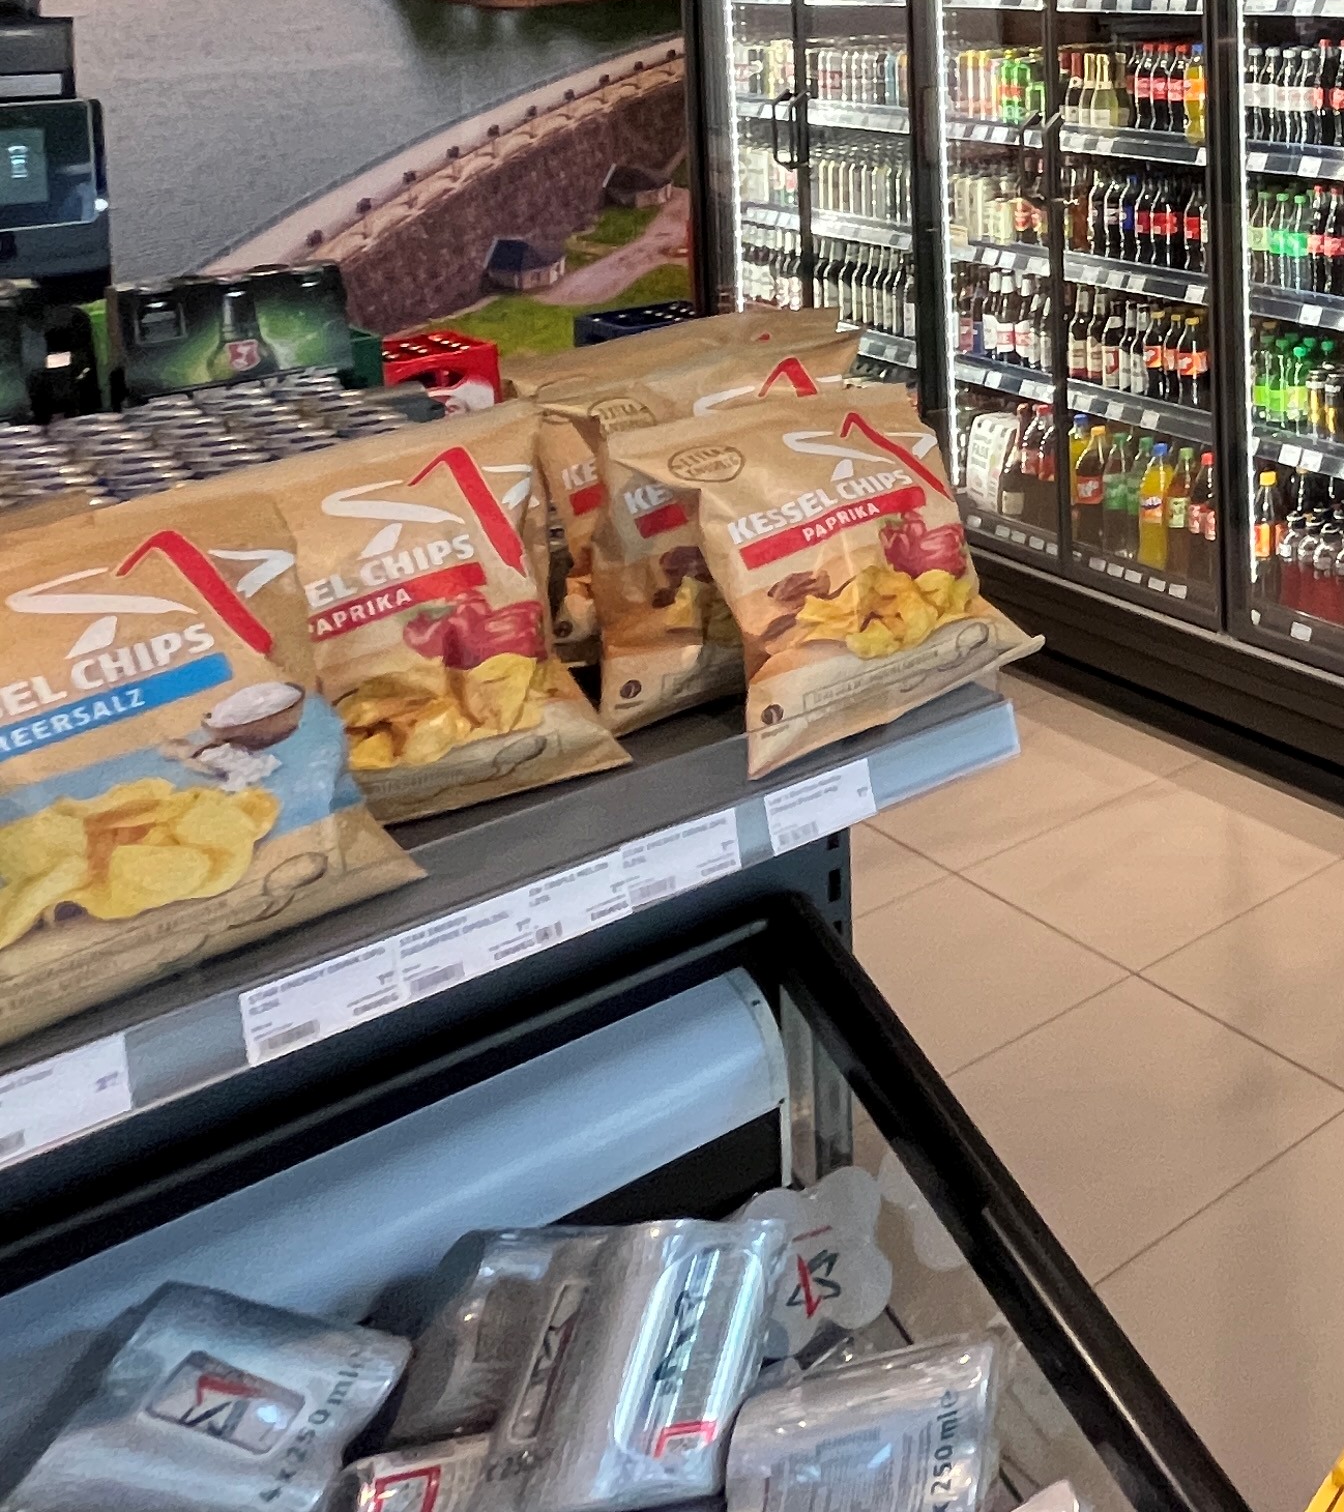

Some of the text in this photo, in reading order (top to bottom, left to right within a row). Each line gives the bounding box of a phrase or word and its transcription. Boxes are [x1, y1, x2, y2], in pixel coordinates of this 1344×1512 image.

[836, 468, 914, 501] CHIPS
[727, 488, 839, 545] KESSEL
[801, 502, 881, 543] PAPRIKA
[359, 534, 475, 587] CHIPS
[70, 623, 215, 690] CHIPS
[930, 1442, 956, 1492] 250
